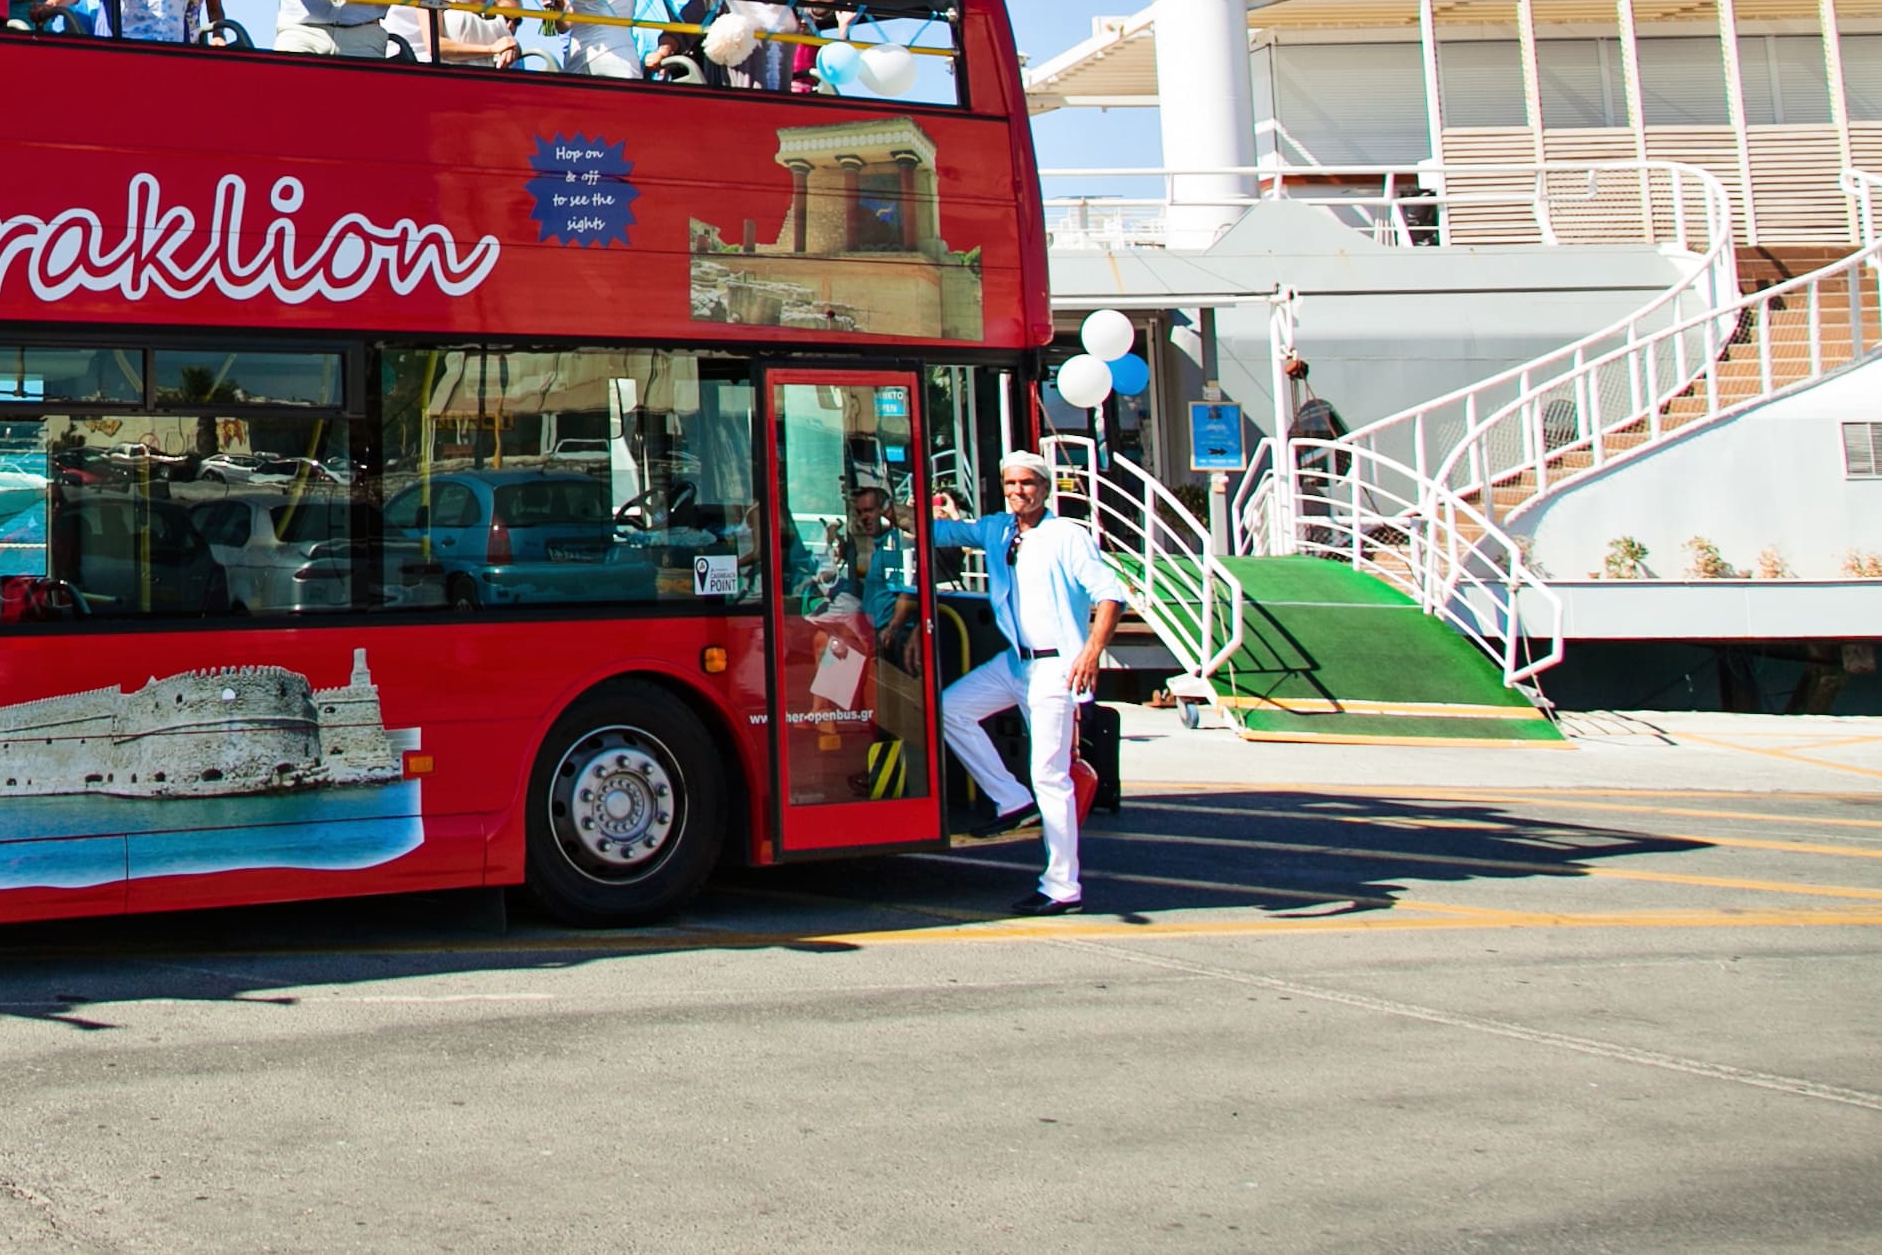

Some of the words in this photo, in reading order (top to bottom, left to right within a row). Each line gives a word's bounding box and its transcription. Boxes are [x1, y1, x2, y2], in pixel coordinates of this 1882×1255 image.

[555, 146, 583, 162] Hop
[585, 150, 604, 158] on
[565, 171, 576, 182] &
[581, 170, 601, 185] off
[552, 194, 567, 207] to
[569, 196, 589, 207] see
[591, 193, 615, 206] the
[566, 216, 606, 233] sights
[710, 579, 736, 593] POINT
